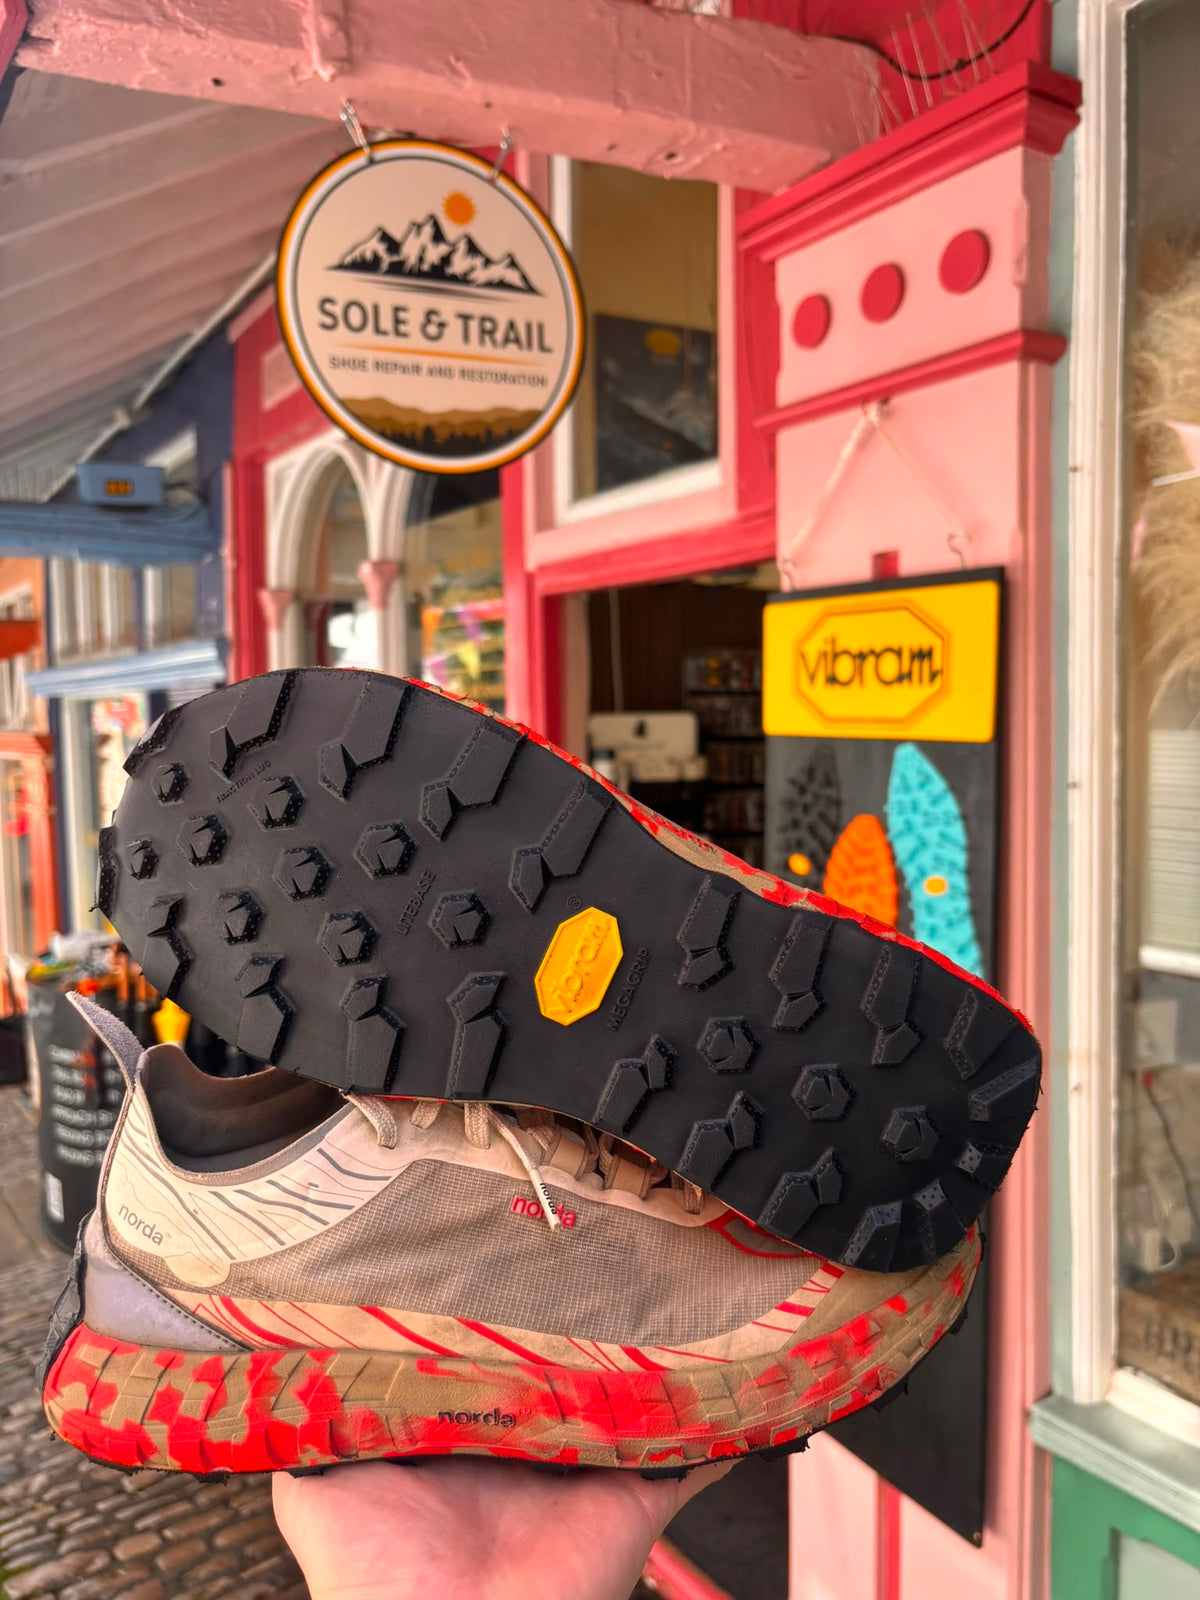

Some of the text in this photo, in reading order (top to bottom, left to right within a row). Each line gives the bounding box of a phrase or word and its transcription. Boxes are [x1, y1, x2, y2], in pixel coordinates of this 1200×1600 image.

[317, 297, 553, 354] SOLE & TRAIL
[329, 356, 547, 388] SHOE REPAIR AND RESTORATION
[800, 636, 942, 687] vibram
[606, 946, 651, 1032] MEGAGRIP
